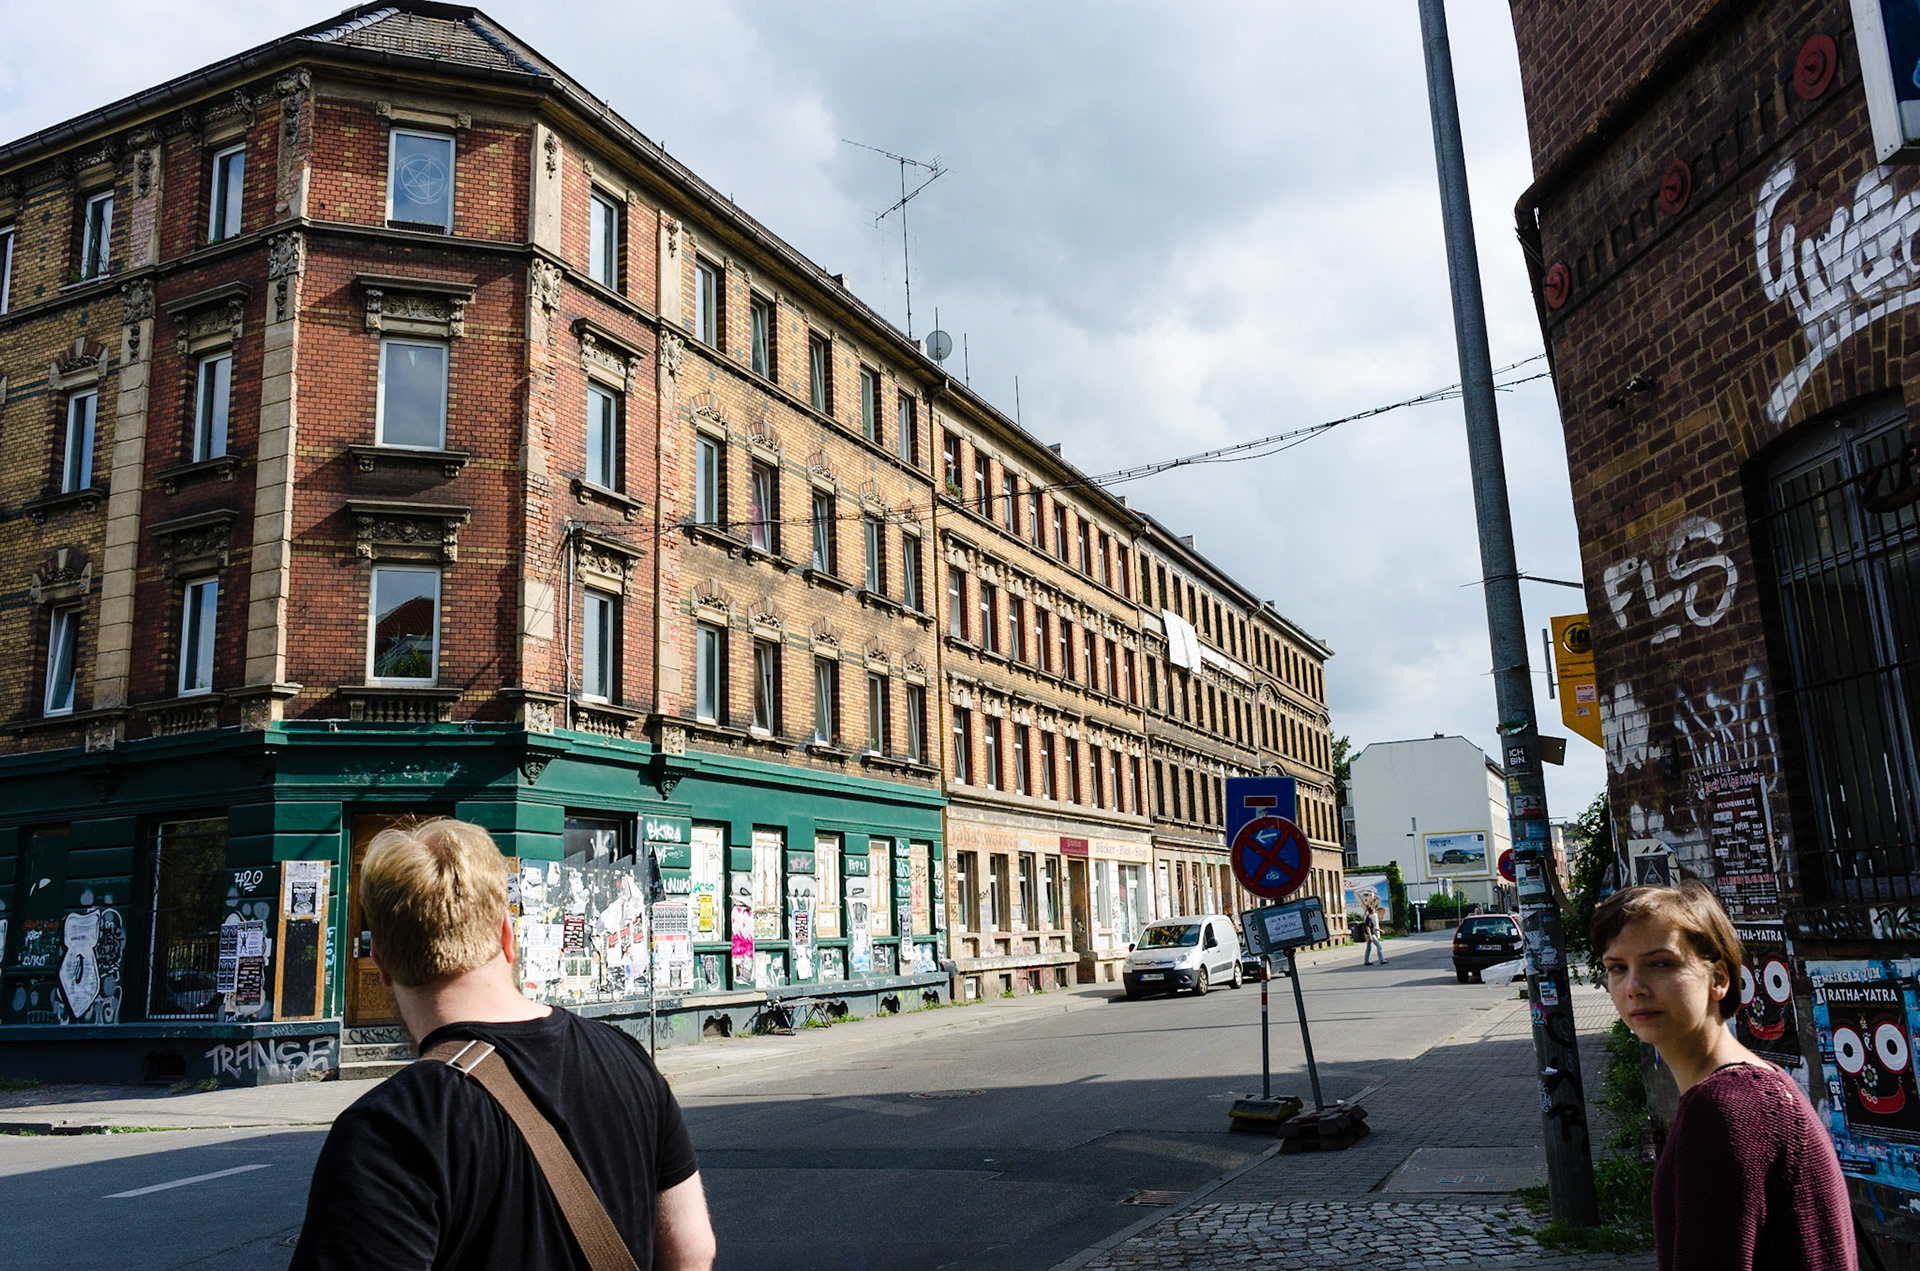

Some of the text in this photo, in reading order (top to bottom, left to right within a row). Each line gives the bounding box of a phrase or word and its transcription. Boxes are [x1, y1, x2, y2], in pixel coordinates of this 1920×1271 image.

[1509, 747, 1524, 757] ICH
[235, 870, 264, 887] 420
[1736, 929, 1783, 942] THA-YATRA
[1827, 988, 1898, 1002] RATHA-YATRA
